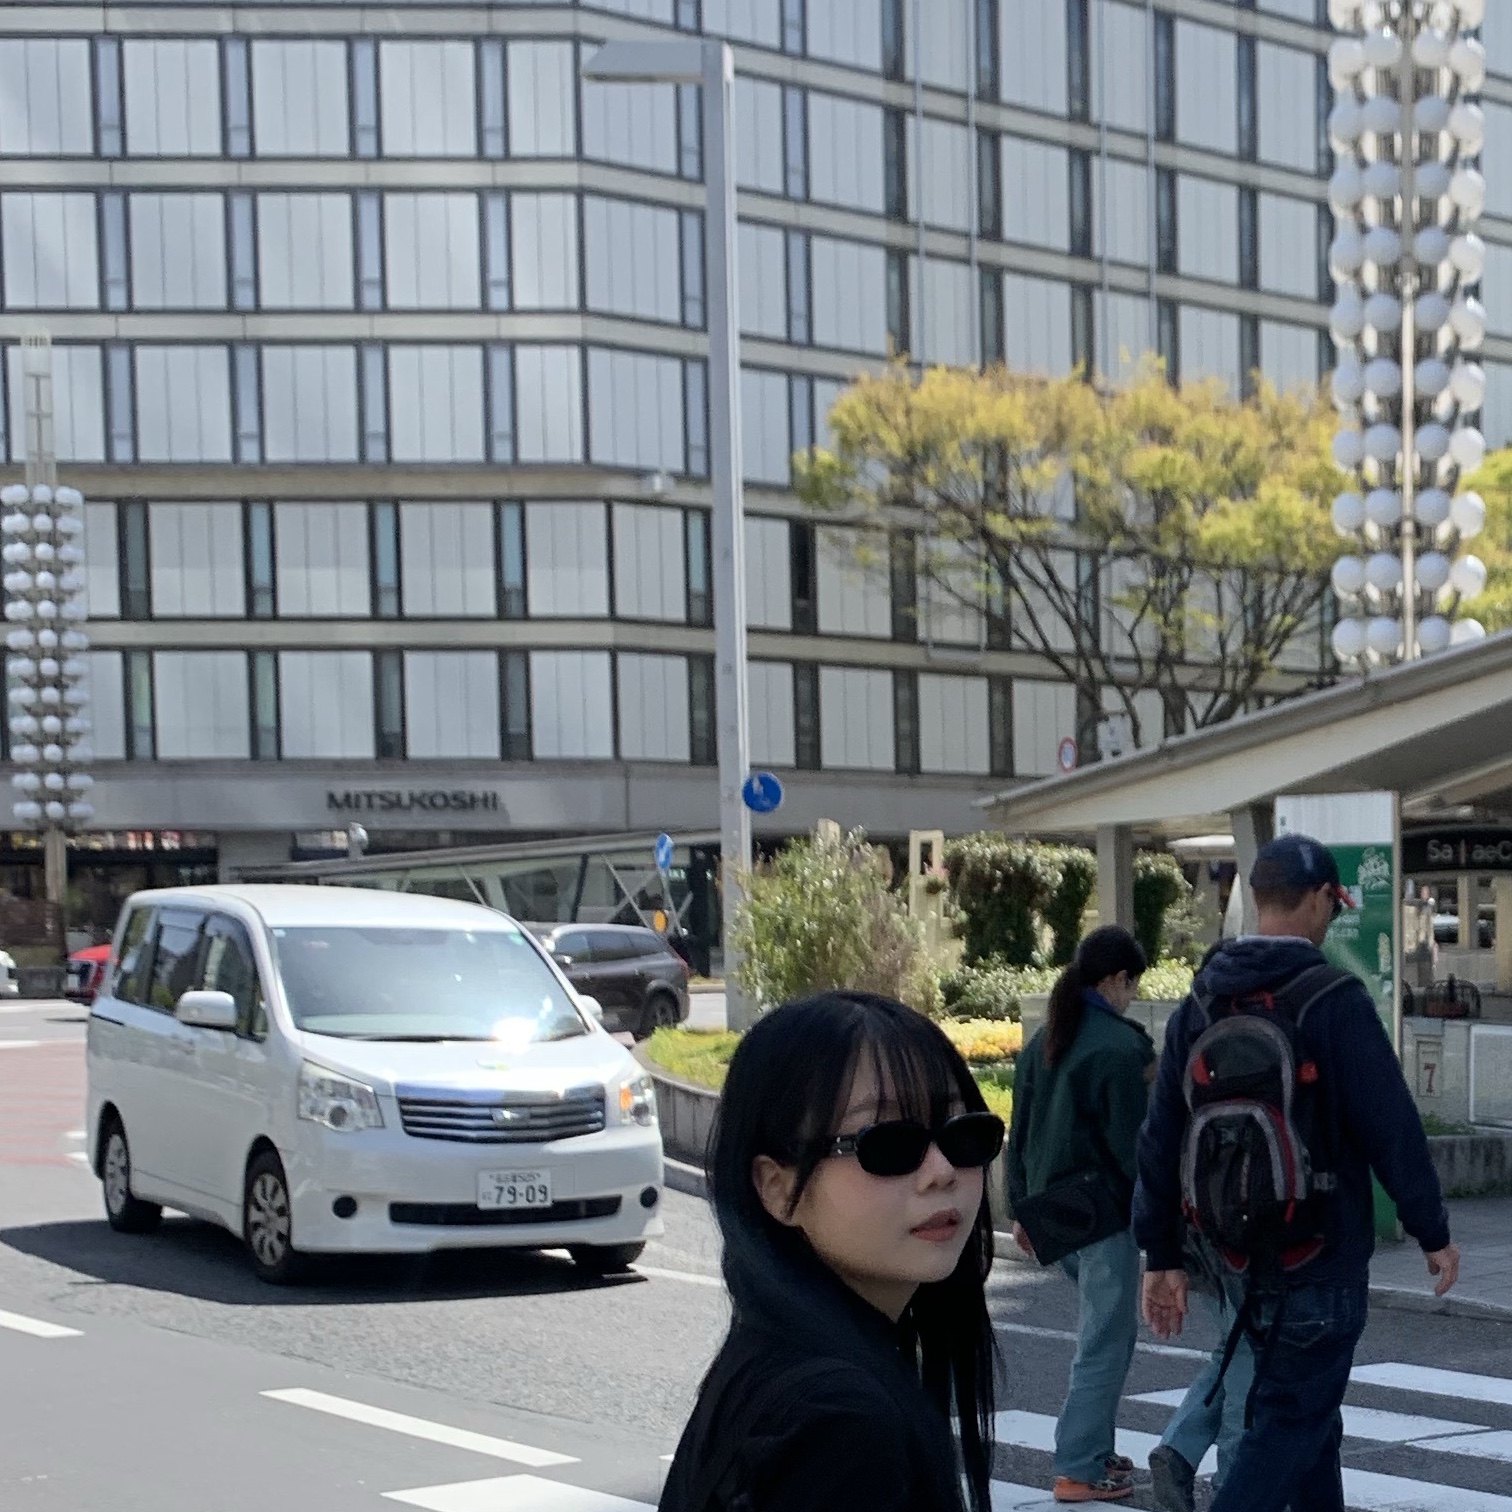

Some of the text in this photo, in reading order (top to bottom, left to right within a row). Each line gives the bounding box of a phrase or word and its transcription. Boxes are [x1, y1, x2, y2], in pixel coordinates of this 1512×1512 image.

[327, 790, 498, 811] MITSUKOSHI
[1424, 1062, 1436, 1092] 7
[494, 1185, 548, 1204] 79-09
